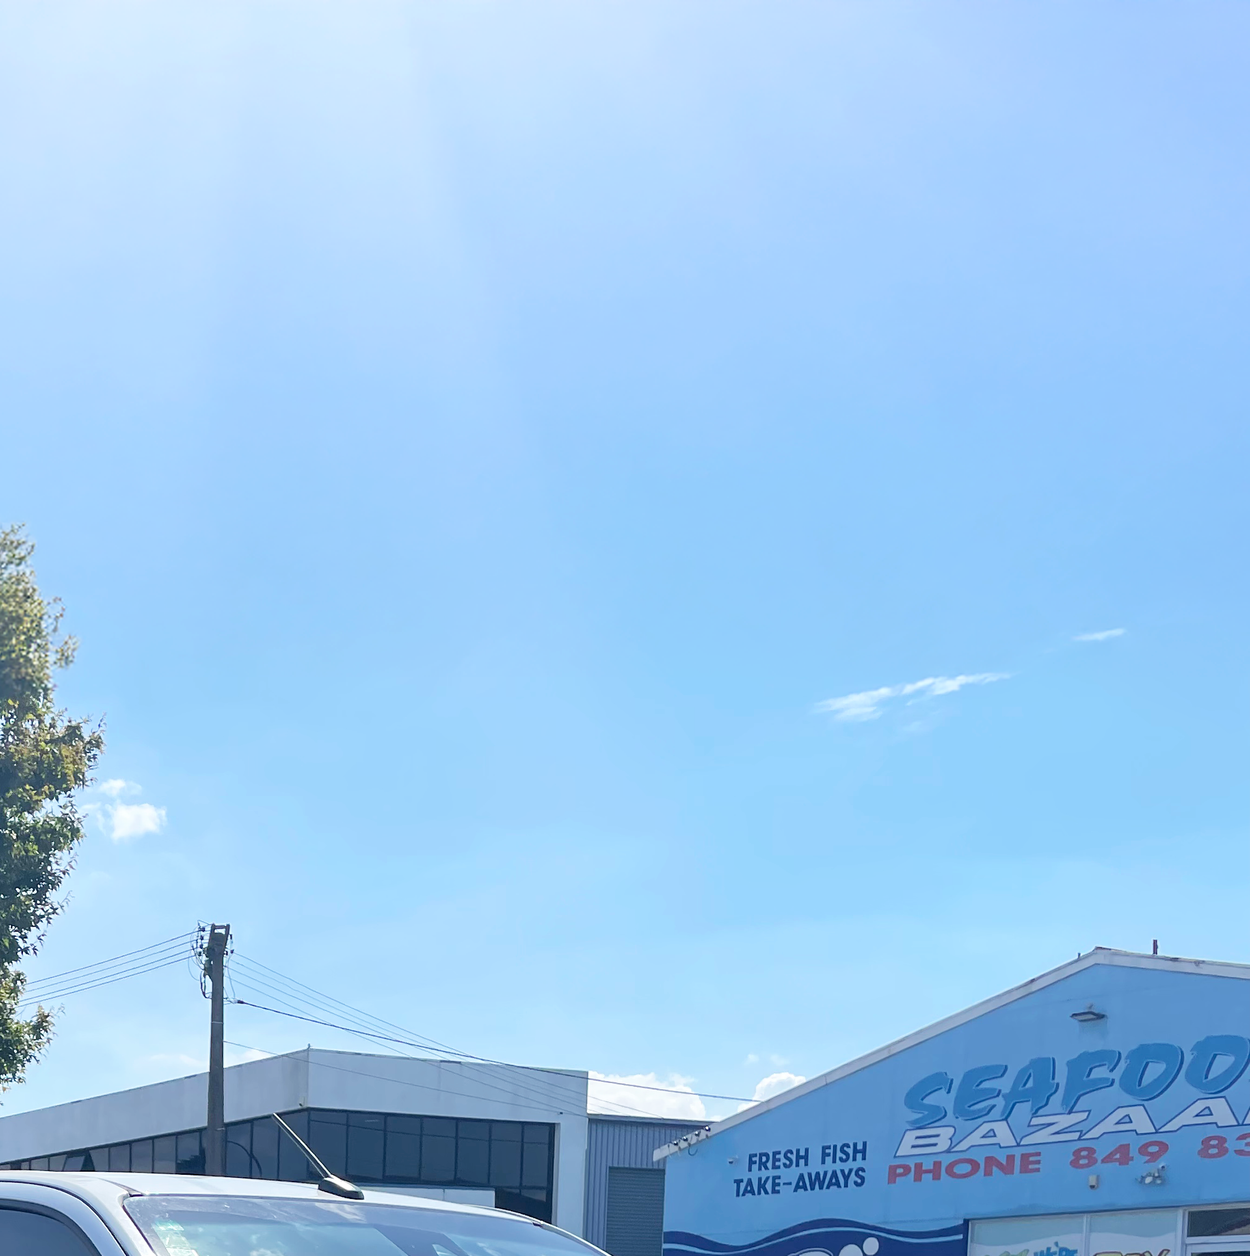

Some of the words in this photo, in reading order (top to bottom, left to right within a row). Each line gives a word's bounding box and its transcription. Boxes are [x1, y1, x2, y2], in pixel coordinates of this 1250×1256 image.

[903, 1034, 1250, 1128] SEAFOO
[893, 1095, 1250, 1158] BAZAA
[747, 1147, 810, 1173] FRESH
[821, 1140, 867, 1165] FISH
[887, 1151, 1042, 1184] PHONE
[1069, 1140, 1170, 1170] 849
[733, 1167, 866, 1197] TAKE-AWAYS
